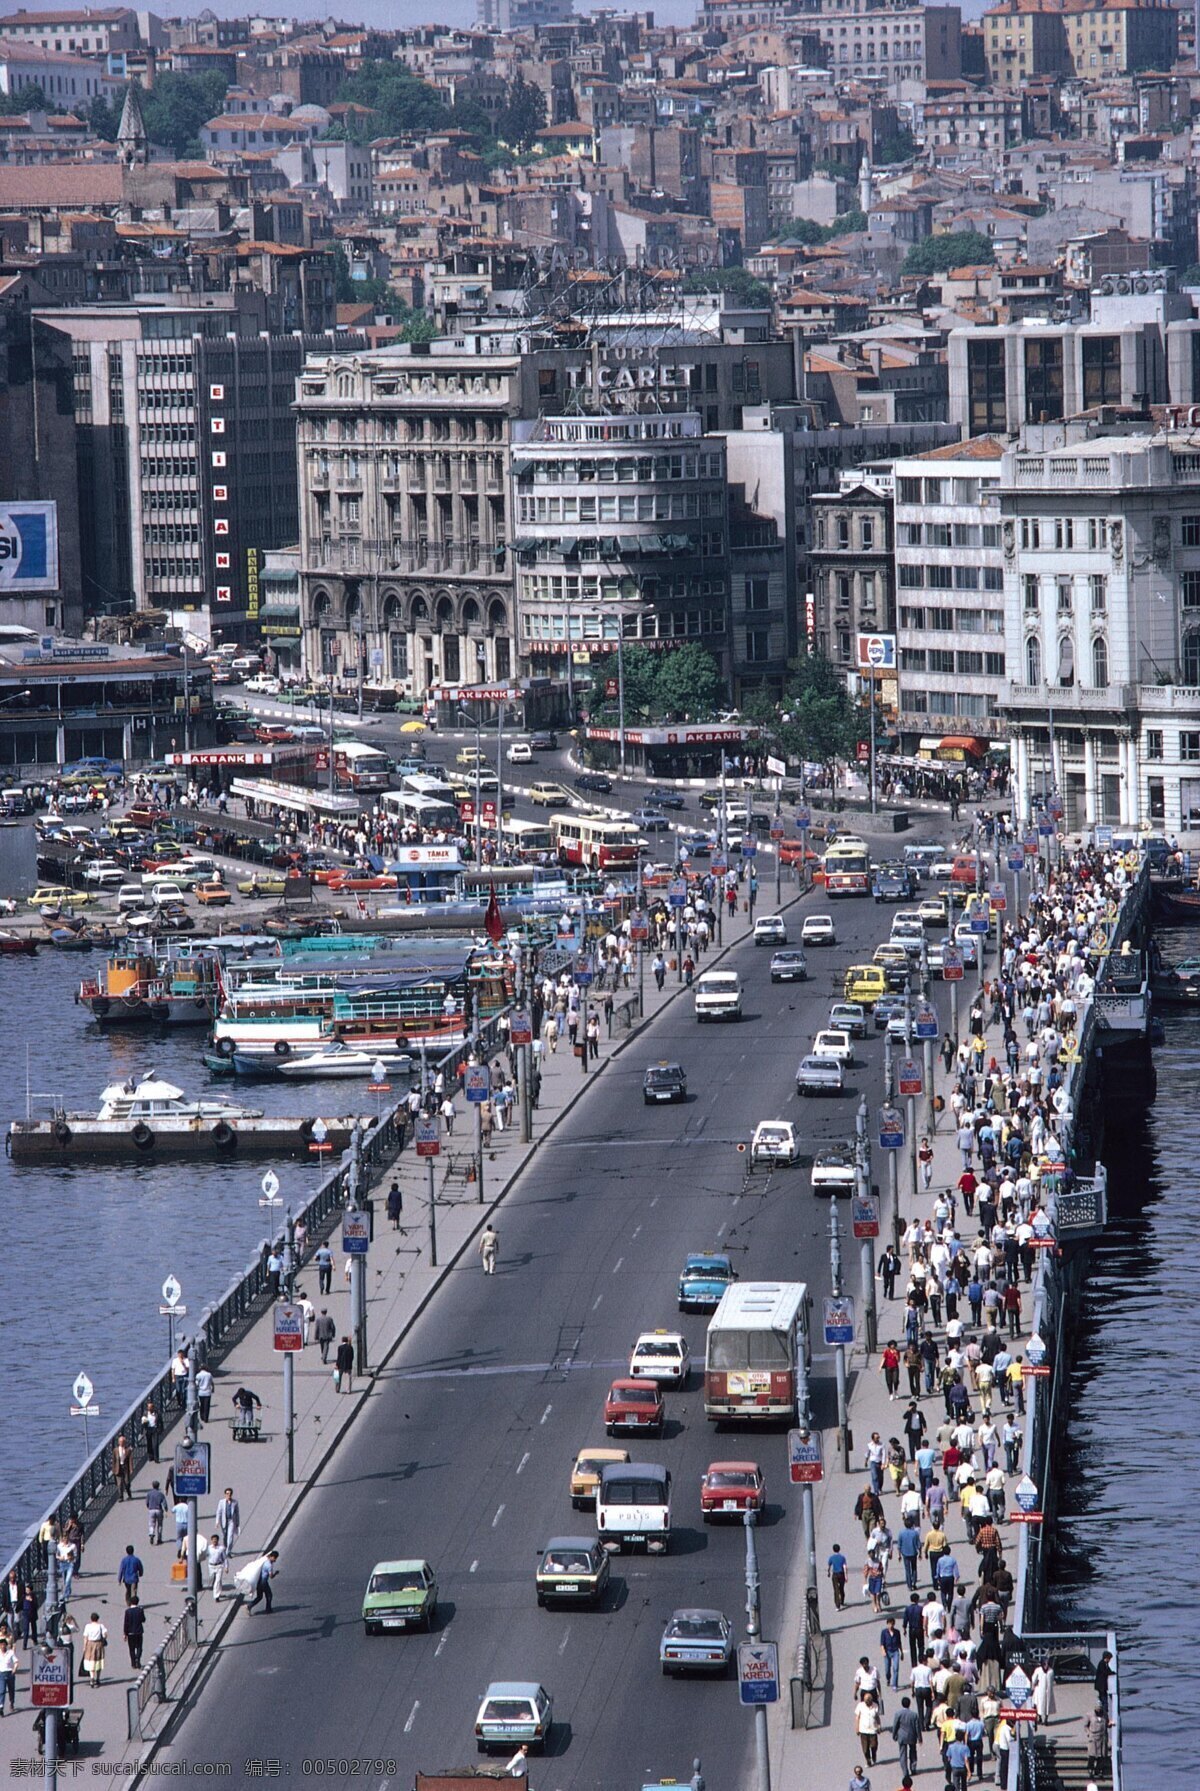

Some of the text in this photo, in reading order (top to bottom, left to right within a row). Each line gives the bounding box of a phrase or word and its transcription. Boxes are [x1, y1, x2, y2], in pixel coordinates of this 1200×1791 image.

[458, 691, 507, 699] AKBANK
[687, 732, 741, 741] AKBANK
[191, 755, 245, 763] AKBANK
[746, 1662, 768, 1671] YAPI
